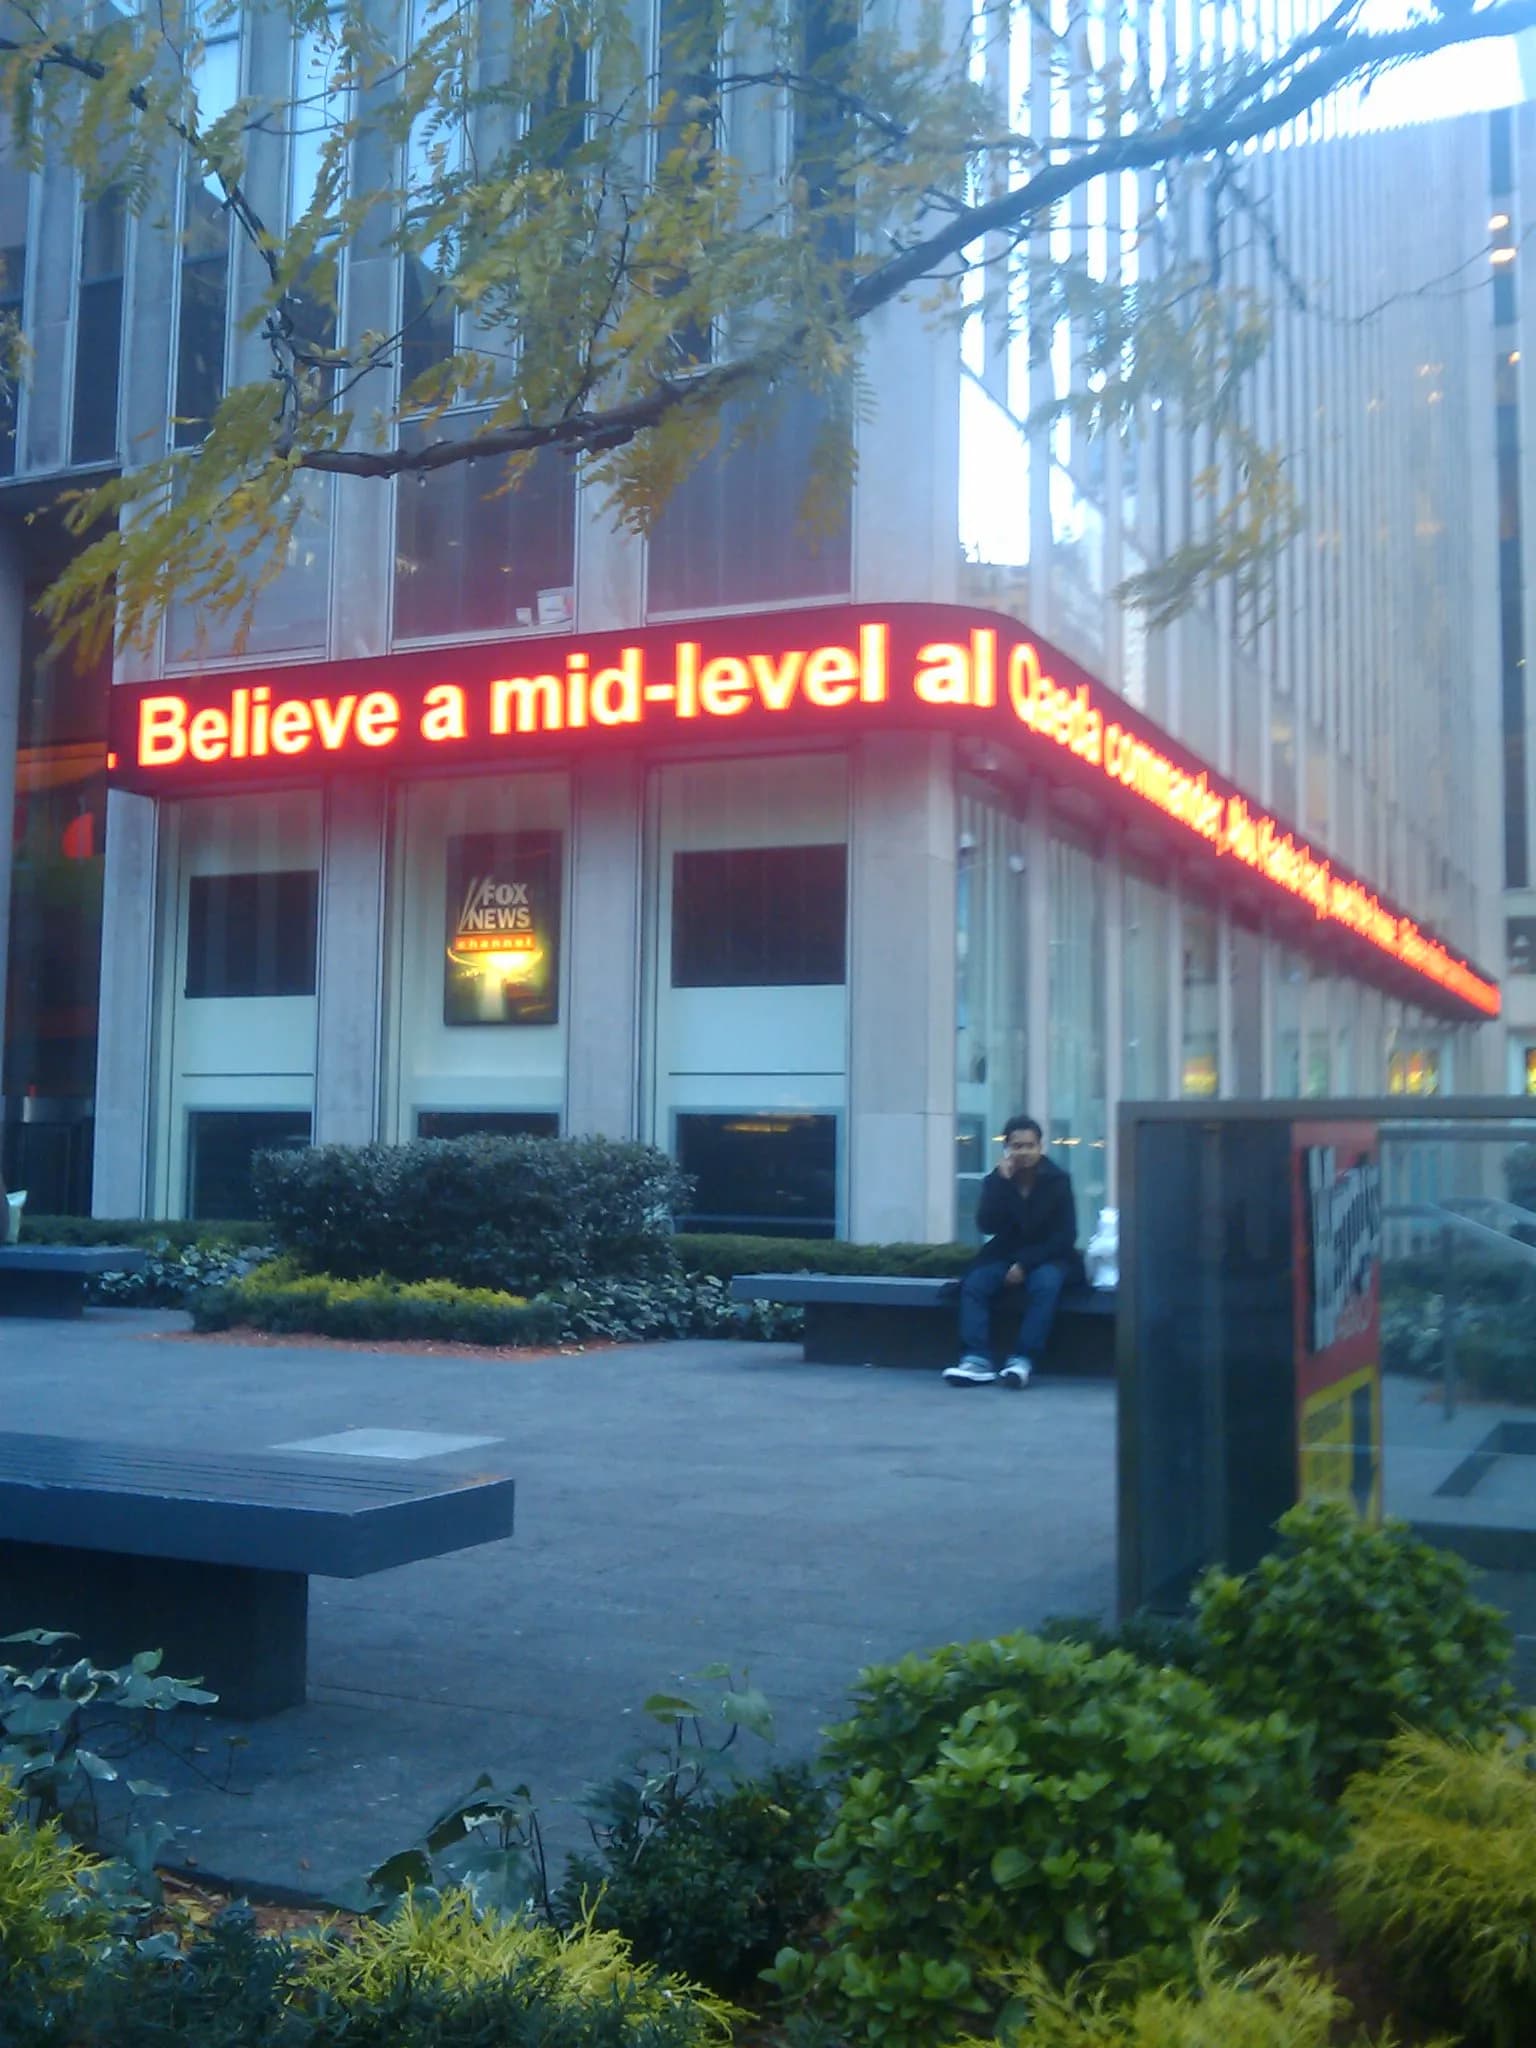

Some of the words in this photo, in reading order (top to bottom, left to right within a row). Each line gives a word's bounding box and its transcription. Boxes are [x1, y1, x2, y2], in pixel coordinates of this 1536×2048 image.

[137, 686, 399, 766] Believe
[420, 684, 467, 742] a
[489, 622, 888, 735] mid-level
[913, 627, 999, 708] al
[483, 885, 528, 906] FOX
[469, 908, 530, 930] NEWS
[457, 936, 532, 950] channel
